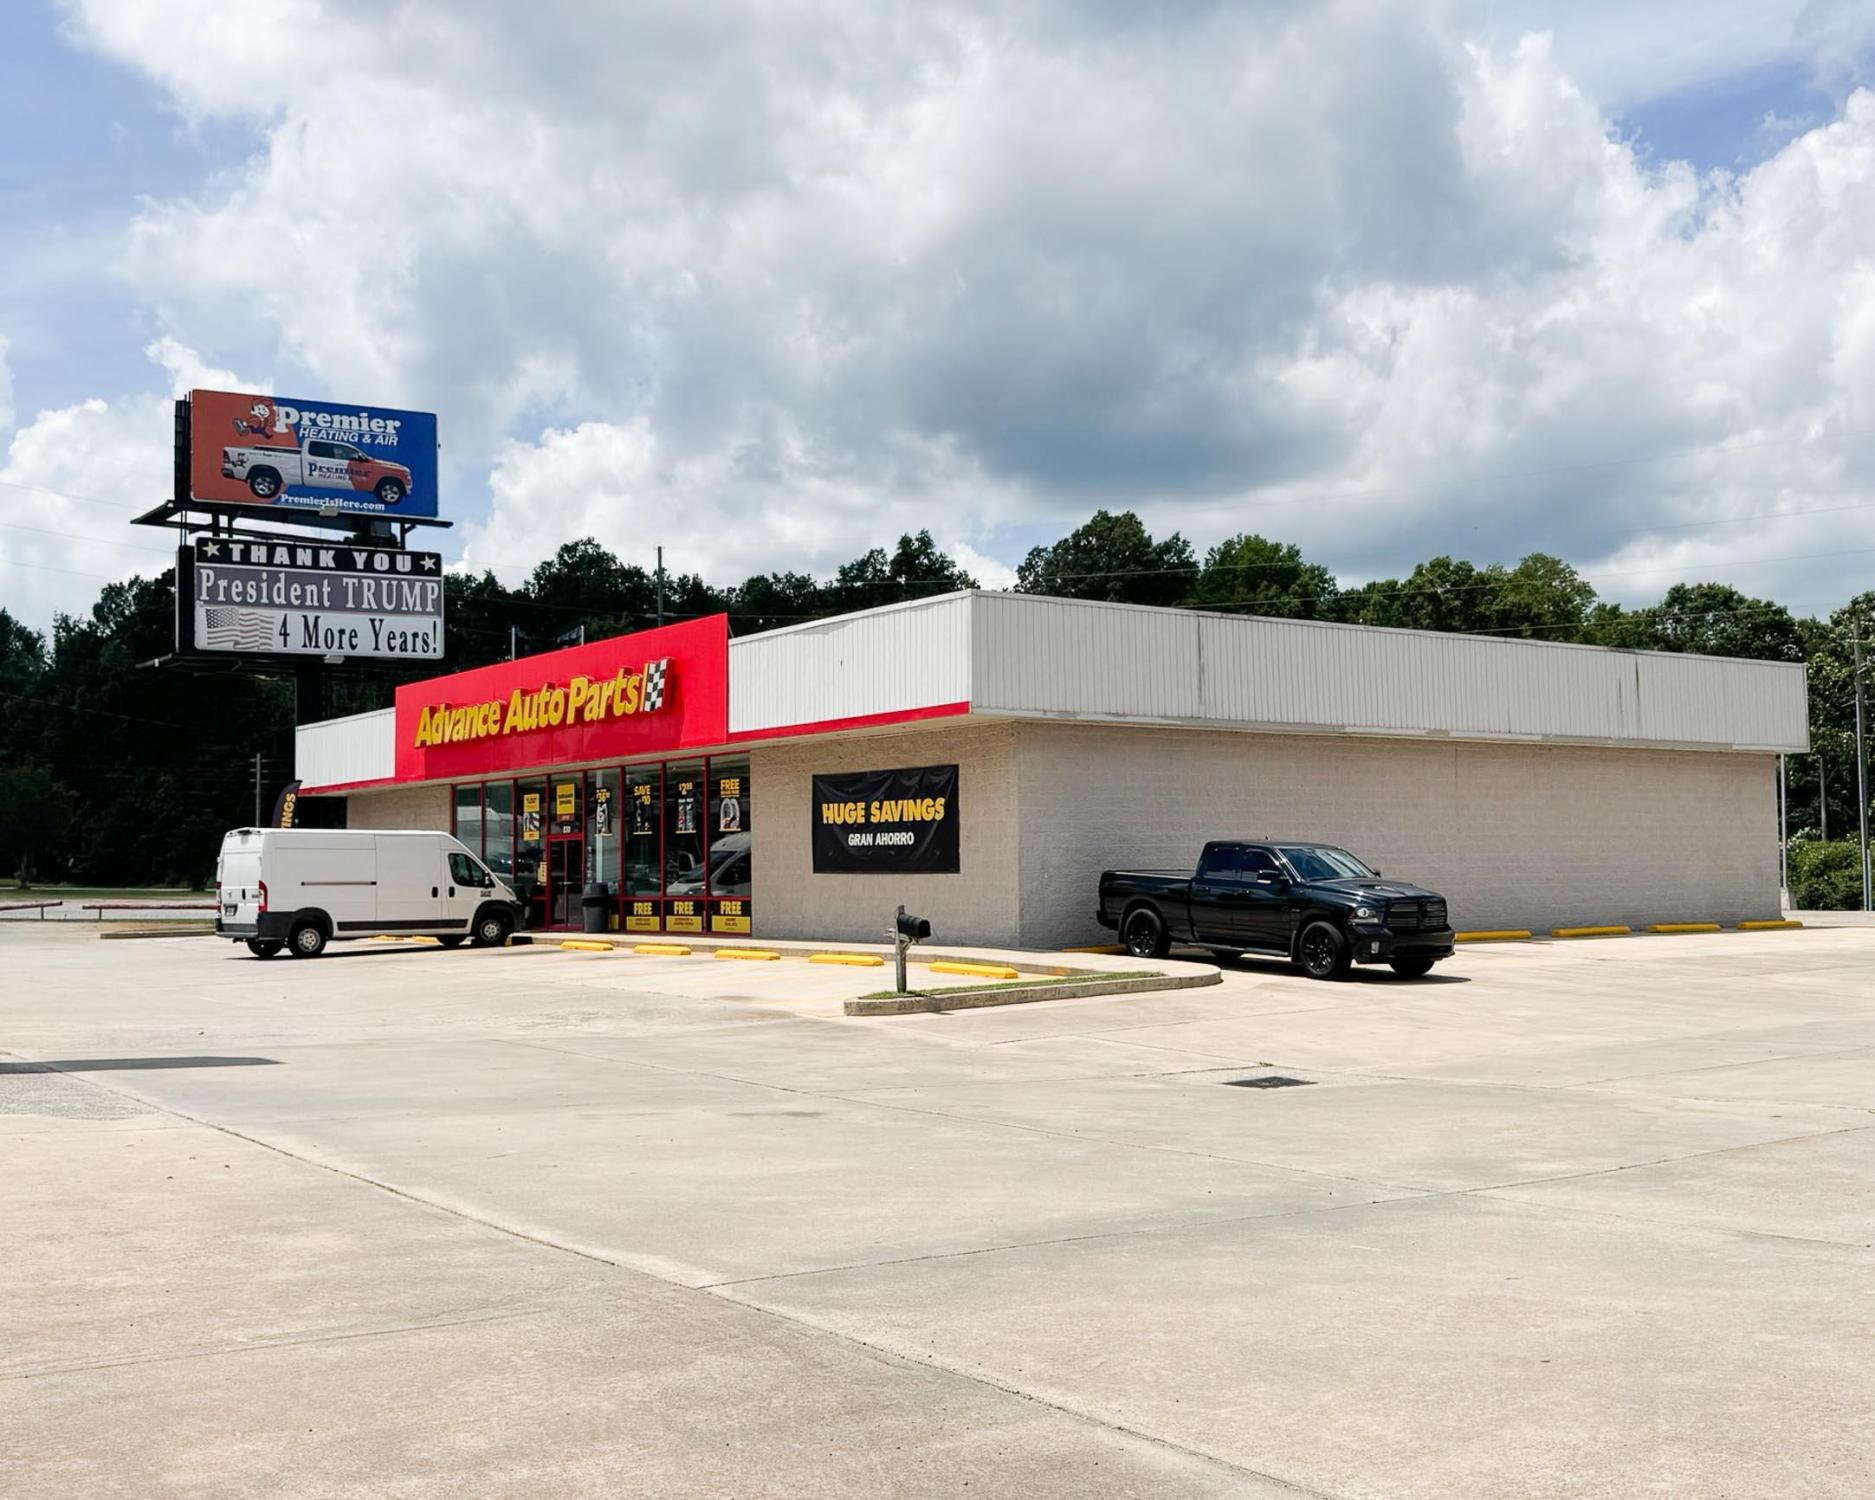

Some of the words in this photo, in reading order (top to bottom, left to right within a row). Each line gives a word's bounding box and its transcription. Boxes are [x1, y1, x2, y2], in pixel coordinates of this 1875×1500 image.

[273, 405, 401, 434] Premier
[299, 428, 359, 443] HEATING
[362, 434, 371, 445] &
[374, 435, 399, 446] AIR
[228, 543, 336, 568] THANK
[353, 551, 412, 572] YOU
[199, 569, 331, 607] President
[343, 577, 440, 613] TRUMP
[278, 613, 290, 648] 4
[301, 614, 359, 650] More
[368, 618, 438, 654] Years!
[414, 701, 501, 747] Advance
[503, 682, 565, 734] Auto
[566, 668, 641, 725] Parts
[634, 784, 651, 796] SAVE
[720, 778, 740, 790] FREE
[822, 802, 866, 824] HUGE
[870, 797, 946, 823] SAVINGS
[848, 833, 873, 846] GRAN
[875, 832, 915, 845] AHORRO
[633, 902, 653, 915] FREE
[673, 901, 694, 915] FREE
[720, 901, 742, 915] FREE
